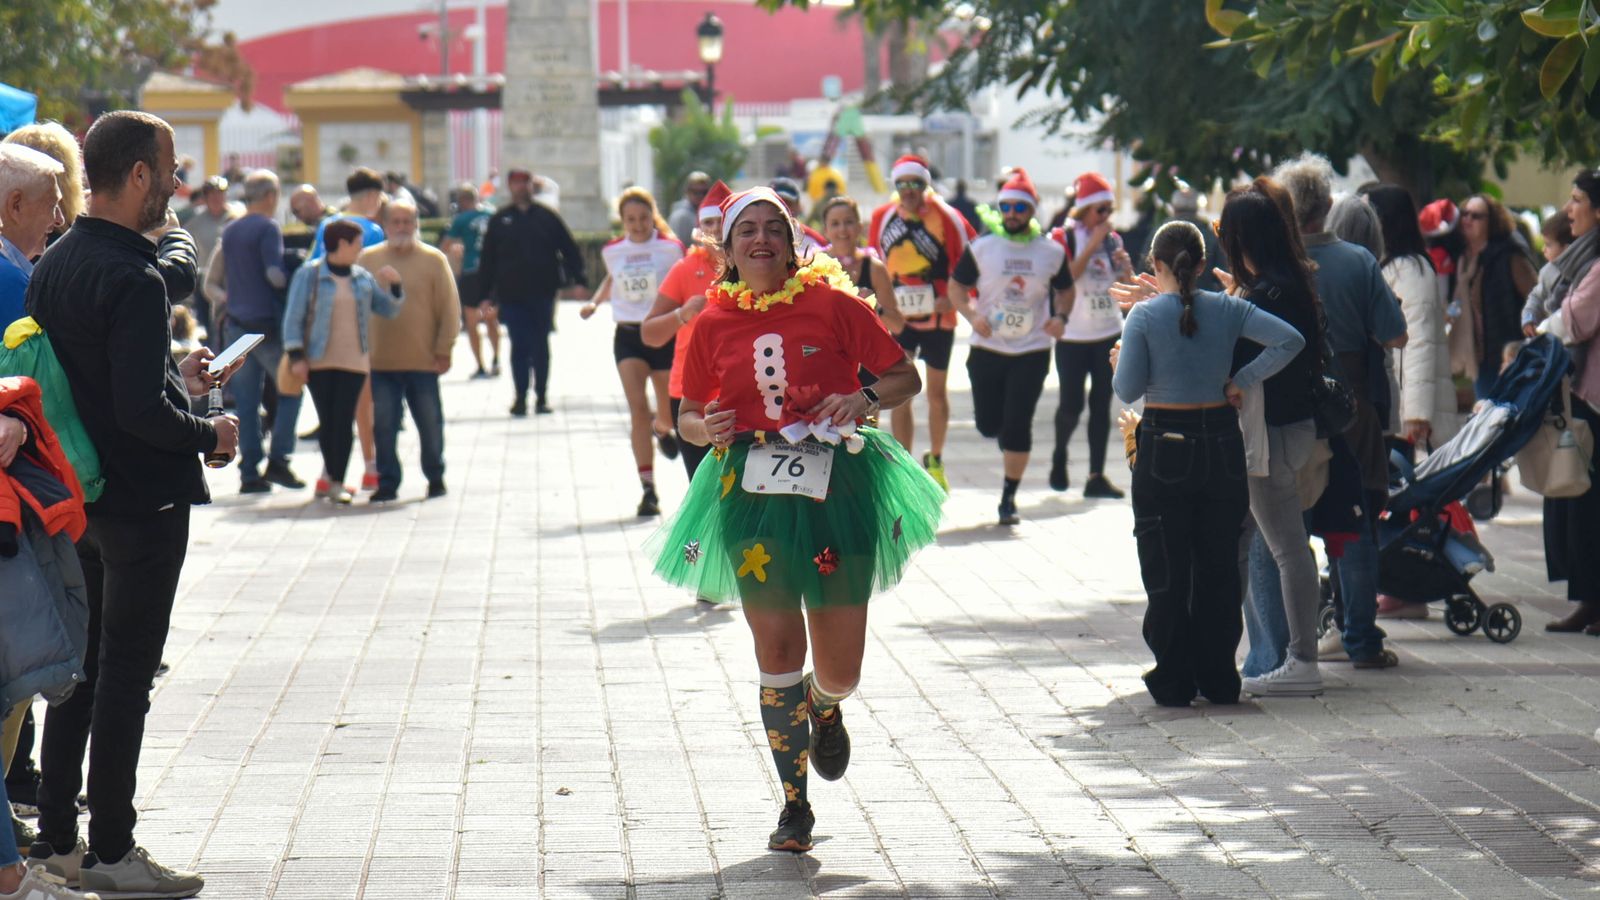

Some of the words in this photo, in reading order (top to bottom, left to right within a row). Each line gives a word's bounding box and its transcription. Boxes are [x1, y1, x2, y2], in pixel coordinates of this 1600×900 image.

[624, 278, 648, 292] 120
[900, 293, 925, 307] 117
[1006, 313, 1025, 328] 02
[771, 453, 805, 478] 76
